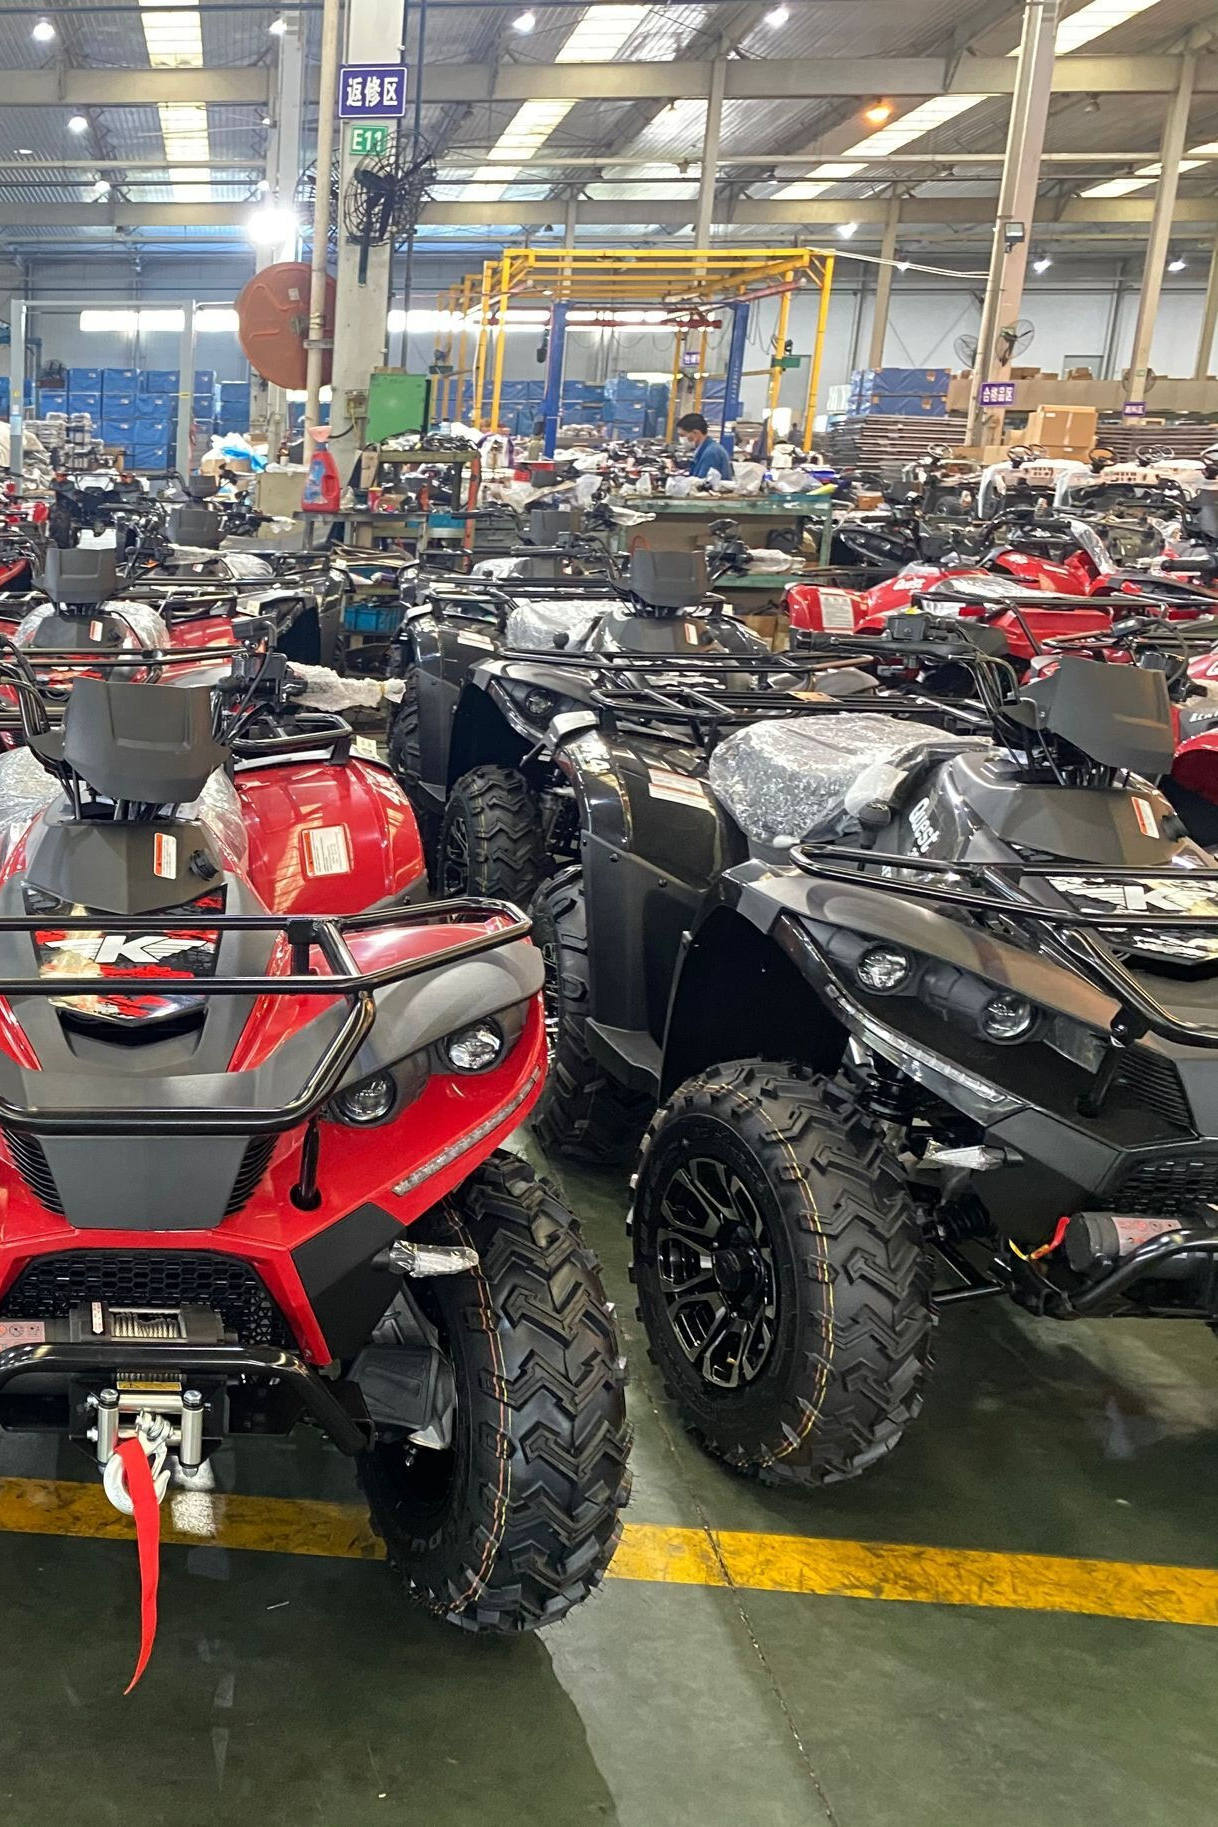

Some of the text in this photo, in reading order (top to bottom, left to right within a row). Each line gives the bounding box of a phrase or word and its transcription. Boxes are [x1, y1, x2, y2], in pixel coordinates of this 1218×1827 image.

[346, 76, 399, 107] 返修区
[908, 797, 940, 854] Quest
